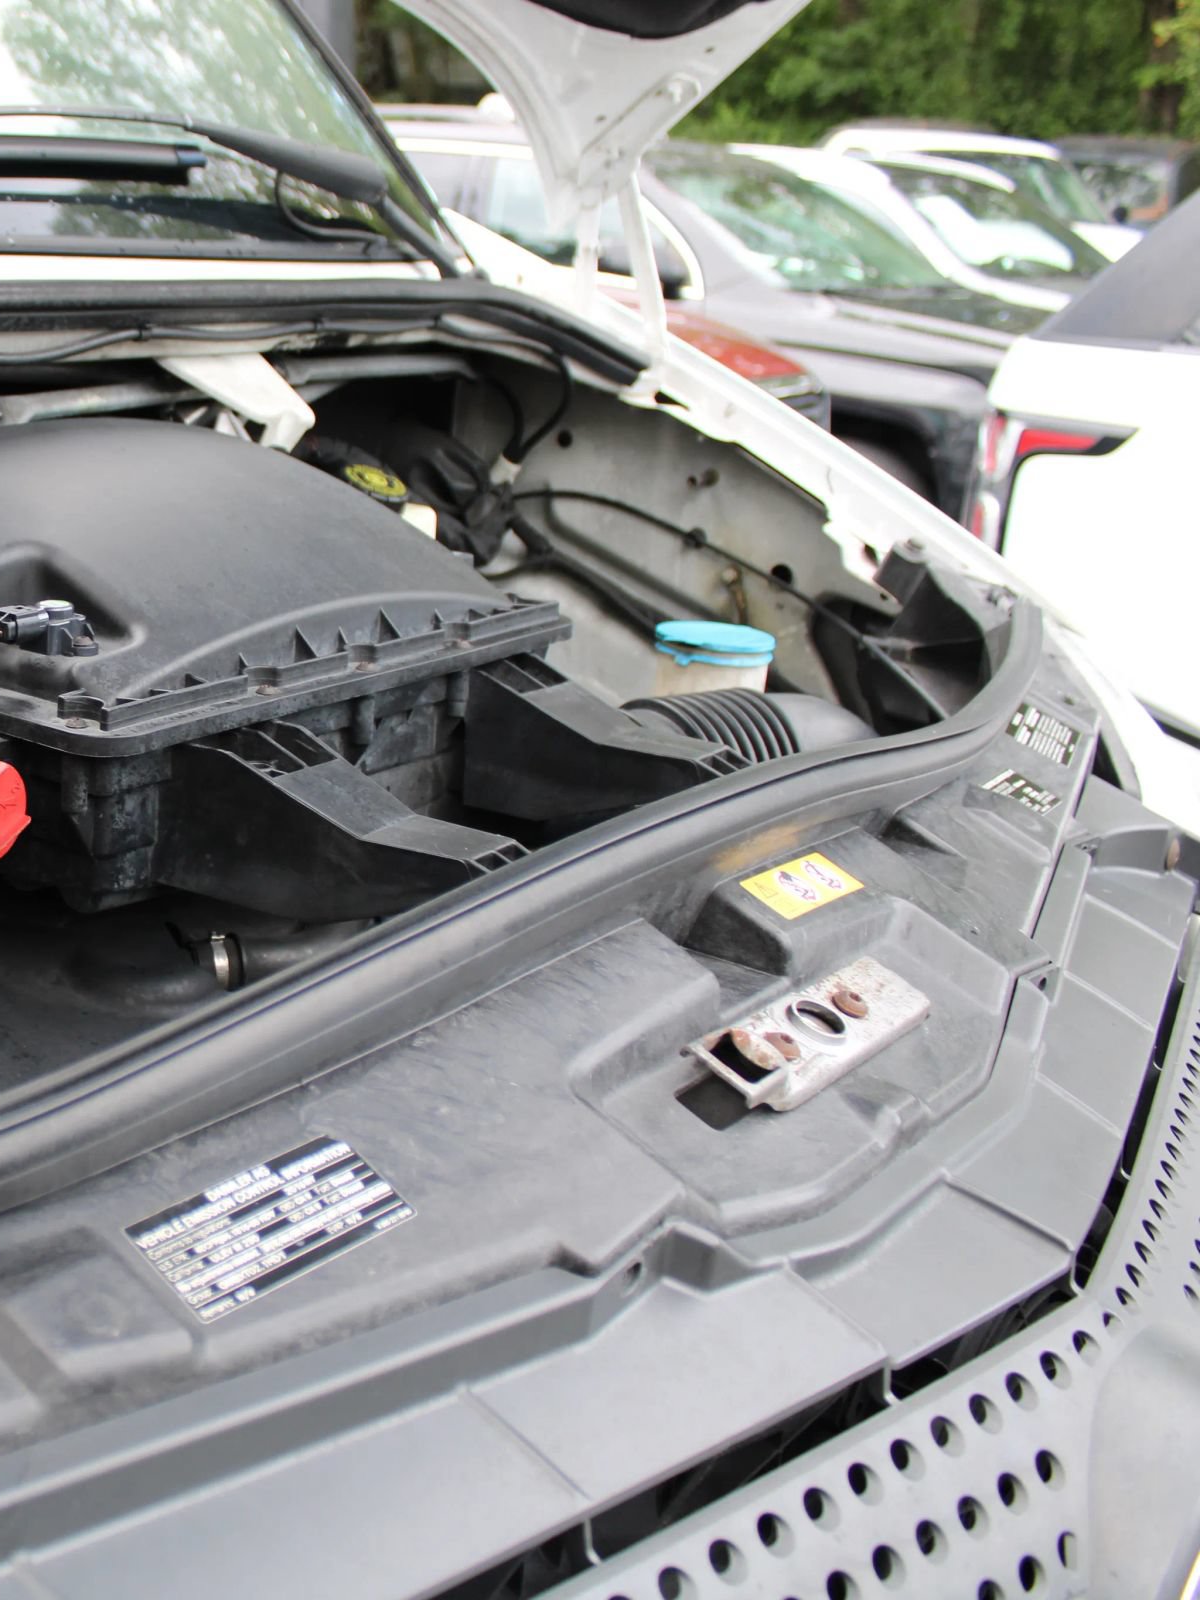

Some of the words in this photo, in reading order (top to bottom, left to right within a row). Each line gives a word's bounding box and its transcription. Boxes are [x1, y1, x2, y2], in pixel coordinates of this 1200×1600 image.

[136, 1220, 186, 1250] VEHICLE
[183, 1196, 236, 1228] EMISSION
[235, 1173, 285, 1204] CONTROL
[280, 1142, 351, 1179] INFORMATION
